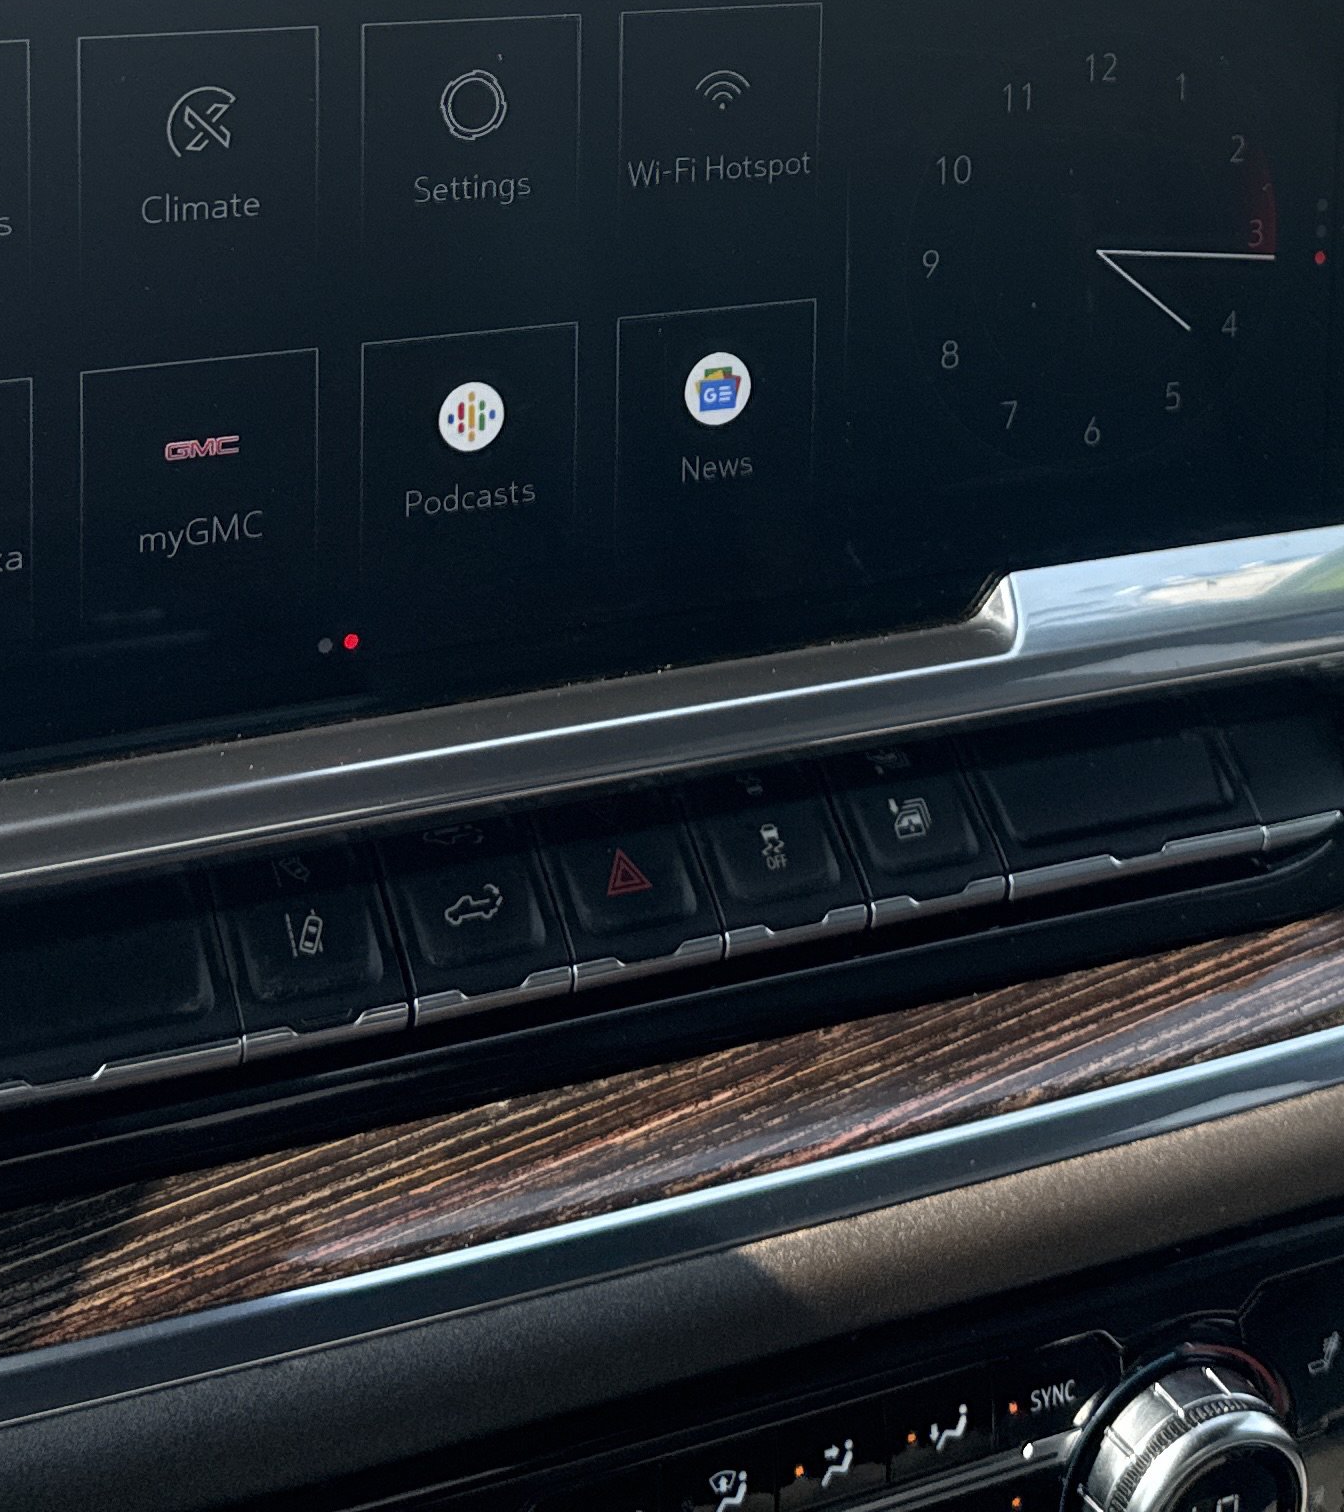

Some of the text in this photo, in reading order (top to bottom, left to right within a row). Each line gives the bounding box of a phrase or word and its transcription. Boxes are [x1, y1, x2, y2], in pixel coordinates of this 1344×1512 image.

[1085, 51, 1118, 83] 12
[1002, 82, 1033, 112] 11
[1175, 72, 1188, 102] 1
[1230, 134, 1246, 164] 2
[627, 152, 812, 188] Wi-Fi Hotspot
[935, 153, 973, 186] 10
[413, 173, 532, 206] Settings
[141, 191, 261, 225] Climate
[1248, 218, 1265, 249] 3
[922, 248, 941, 280] 9
[1221, 310, 1239, 340] 4
[940, 338, 960, 370] 8
[1164, 380, 1182, 412] 5
[1001, 399, 1018, 430] 7
[1083, 415, 1102, 446] 6
[164, 434, 240, 460] GMC
[681, 454, 753, 483] News
[404, 479, 536, 518] Podcasts
[137, 509, 264, 556] myGMC
[1030, 1379, 1076, 1413] SYNC
